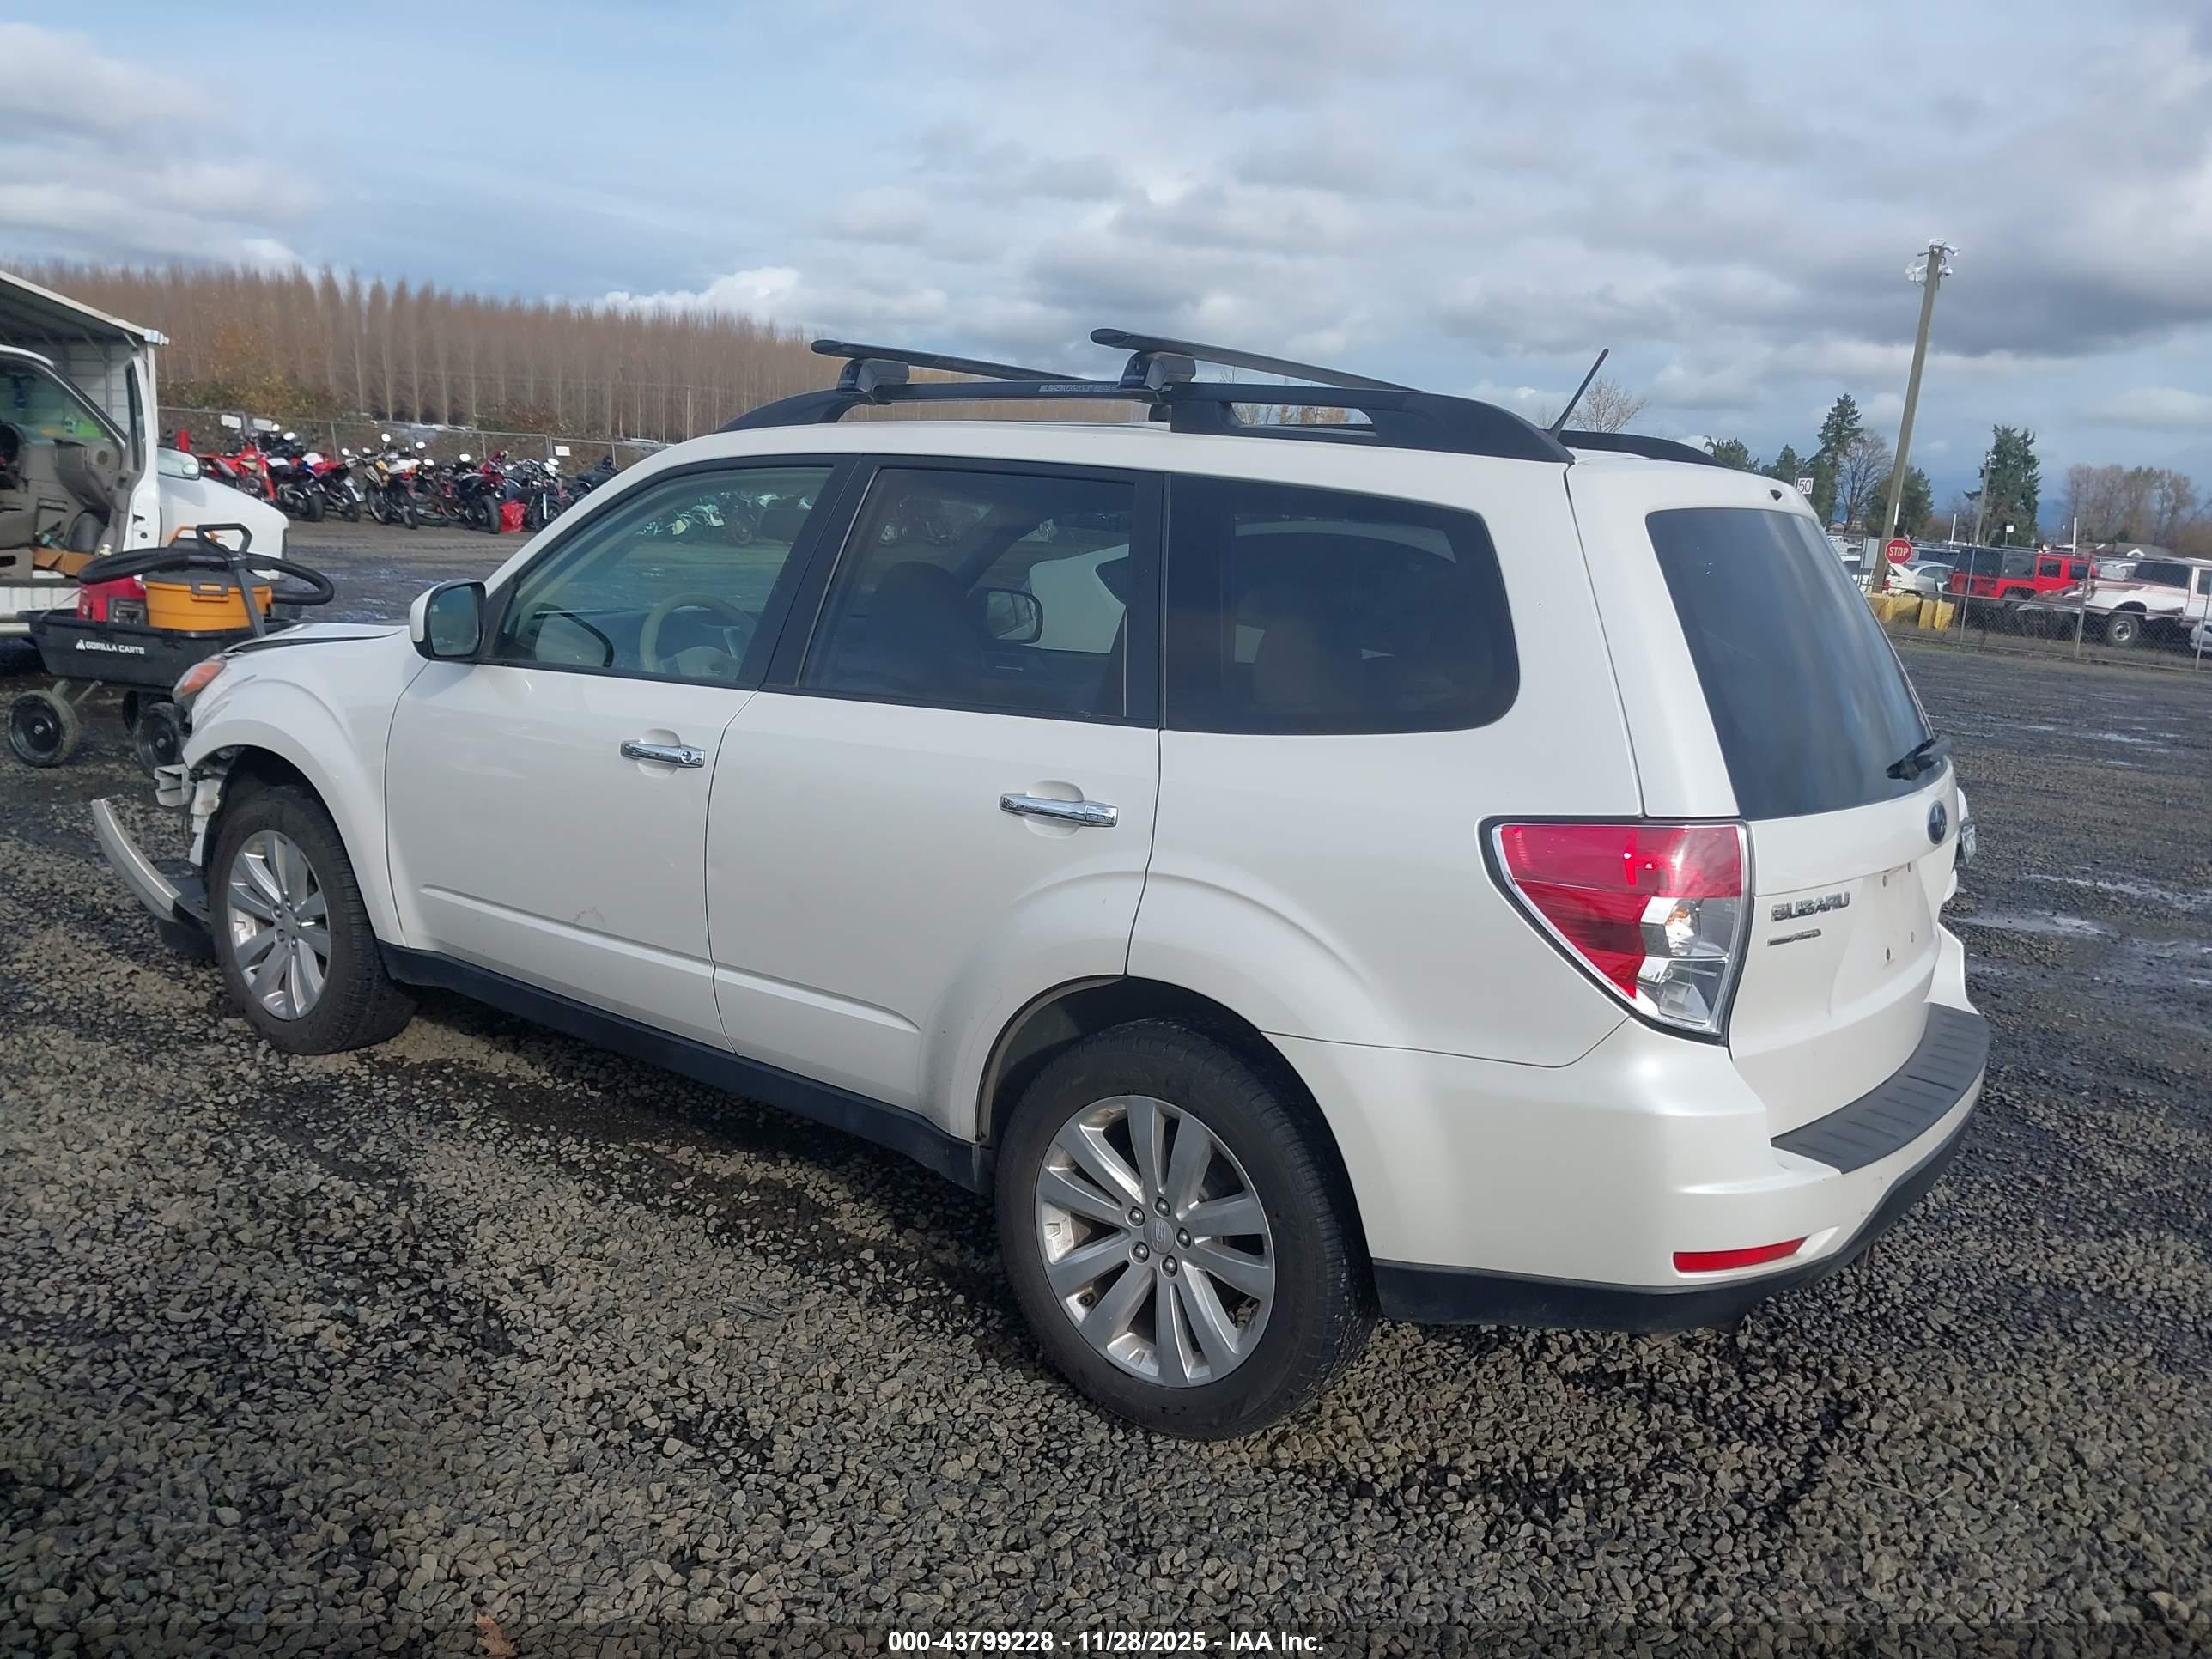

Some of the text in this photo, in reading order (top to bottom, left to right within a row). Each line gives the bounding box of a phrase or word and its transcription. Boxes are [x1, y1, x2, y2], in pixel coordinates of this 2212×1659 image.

[1798, 479, 1812, 493] 50
[1887, 546, 1910, 558] STOP
[85, 641, 145, 655] GORILLA CARTS
[1771, 890, 1850, 922] SUBARU
